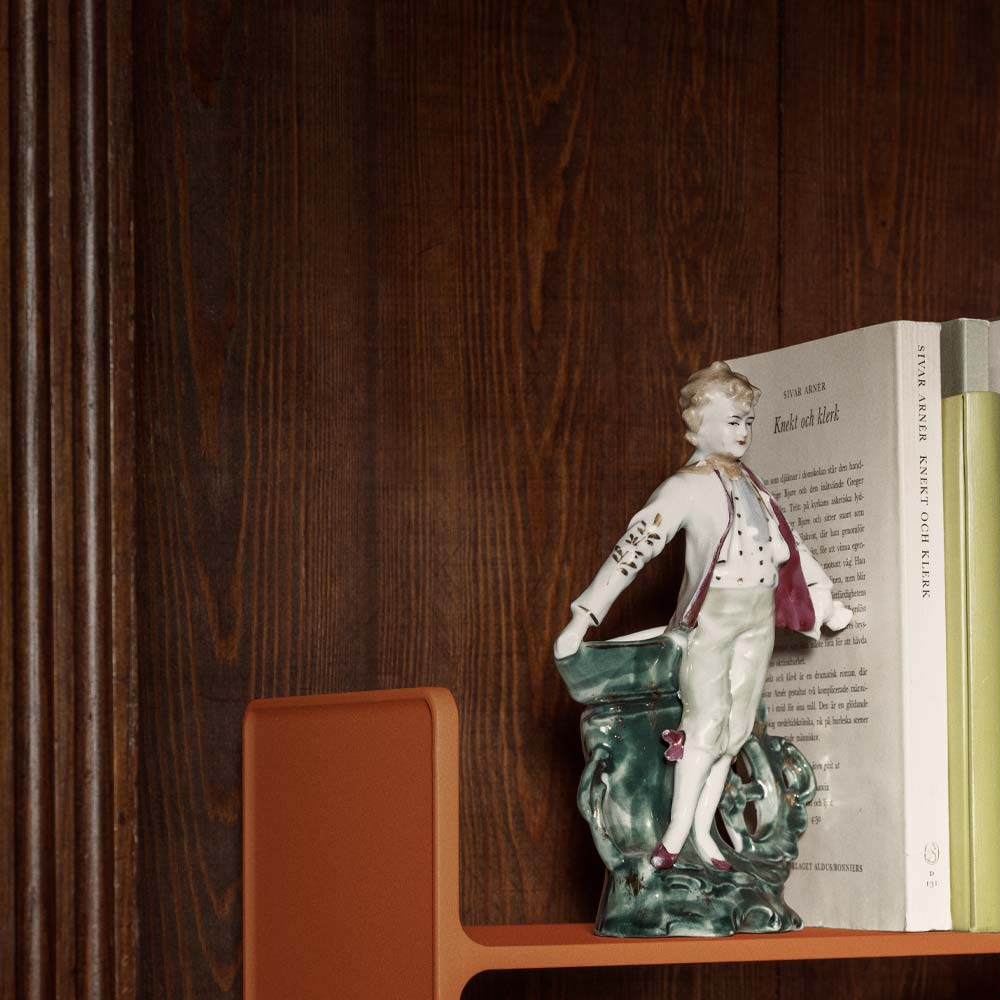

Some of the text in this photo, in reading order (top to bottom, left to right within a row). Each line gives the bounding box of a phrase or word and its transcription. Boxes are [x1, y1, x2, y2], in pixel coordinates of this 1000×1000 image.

[917, 344, 926, 387] SIVAR
[783, 386, 802, 400] SIVAR
[773, 403, 840, 434] Knekt och klerk
[919, 455, 929, 506] KNEKT
[920, 511, 930, 543] OCH
[921, 549, 931, 599] KLERK
